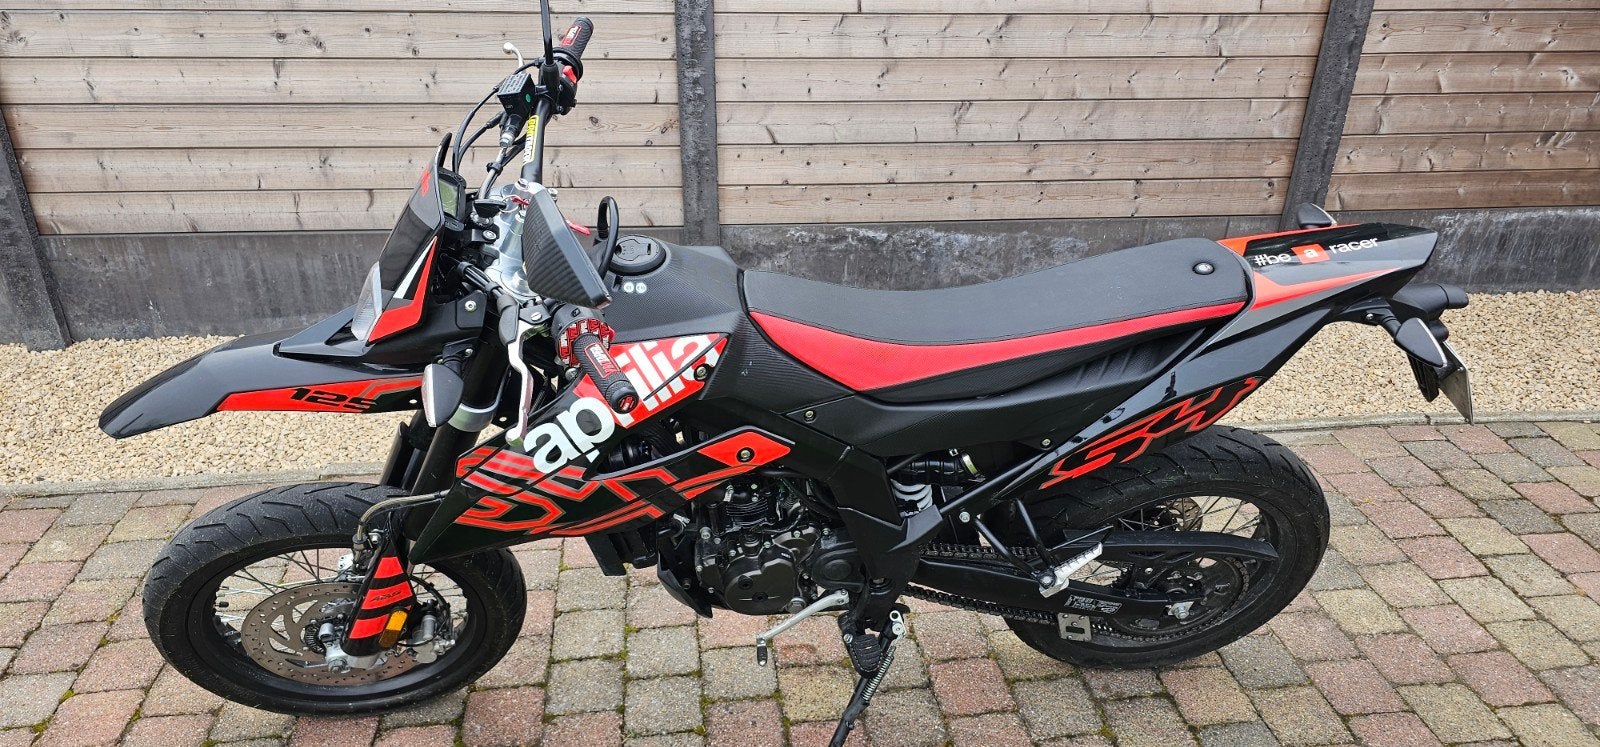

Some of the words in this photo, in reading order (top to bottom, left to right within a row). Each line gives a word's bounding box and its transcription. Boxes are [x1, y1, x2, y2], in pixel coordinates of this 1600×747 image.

[1303, 248, 1319, 258] a
[1329, 237, 1378, 254] racer
[290, 387, 377, 410] 125
[522, 334, 722, 474] apilia
